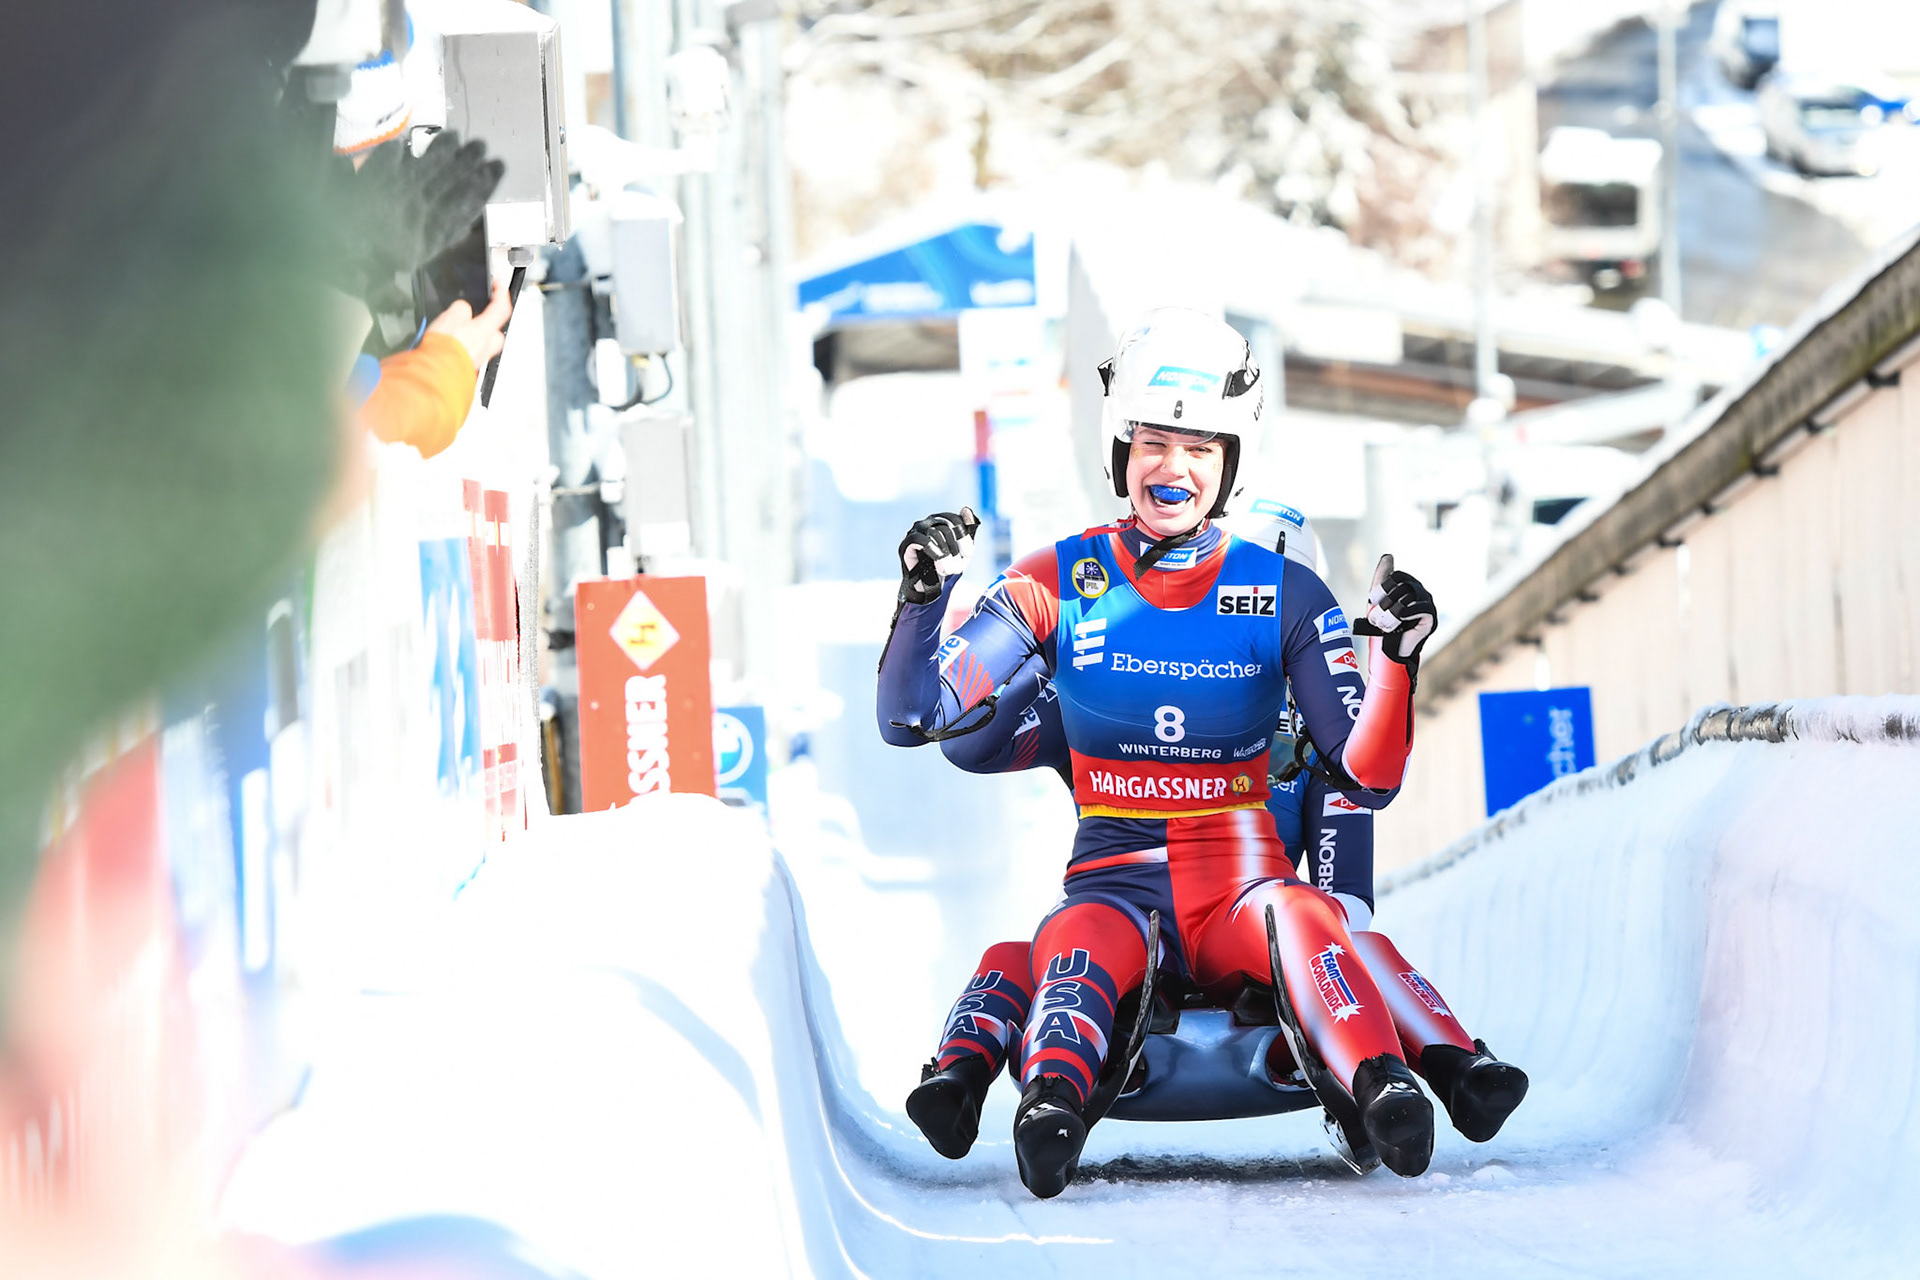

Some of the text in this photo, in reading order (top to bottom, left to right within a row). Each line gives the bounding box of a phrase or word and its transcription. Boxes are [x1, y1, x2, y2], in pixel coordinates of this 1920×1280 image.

[1110, 652, 1263, 681] Eberspächer
[1153, 705, 1186, 743] 8
[1118, 743, 1222, 759] WINTERBERG
[1088, 770, 1228, 801] HARGASSNER
[1321, 951, 1341, 980] TEAM
[947, 970, 1003, 1035] USA
[1034, 948, 1090, 1045] USA
